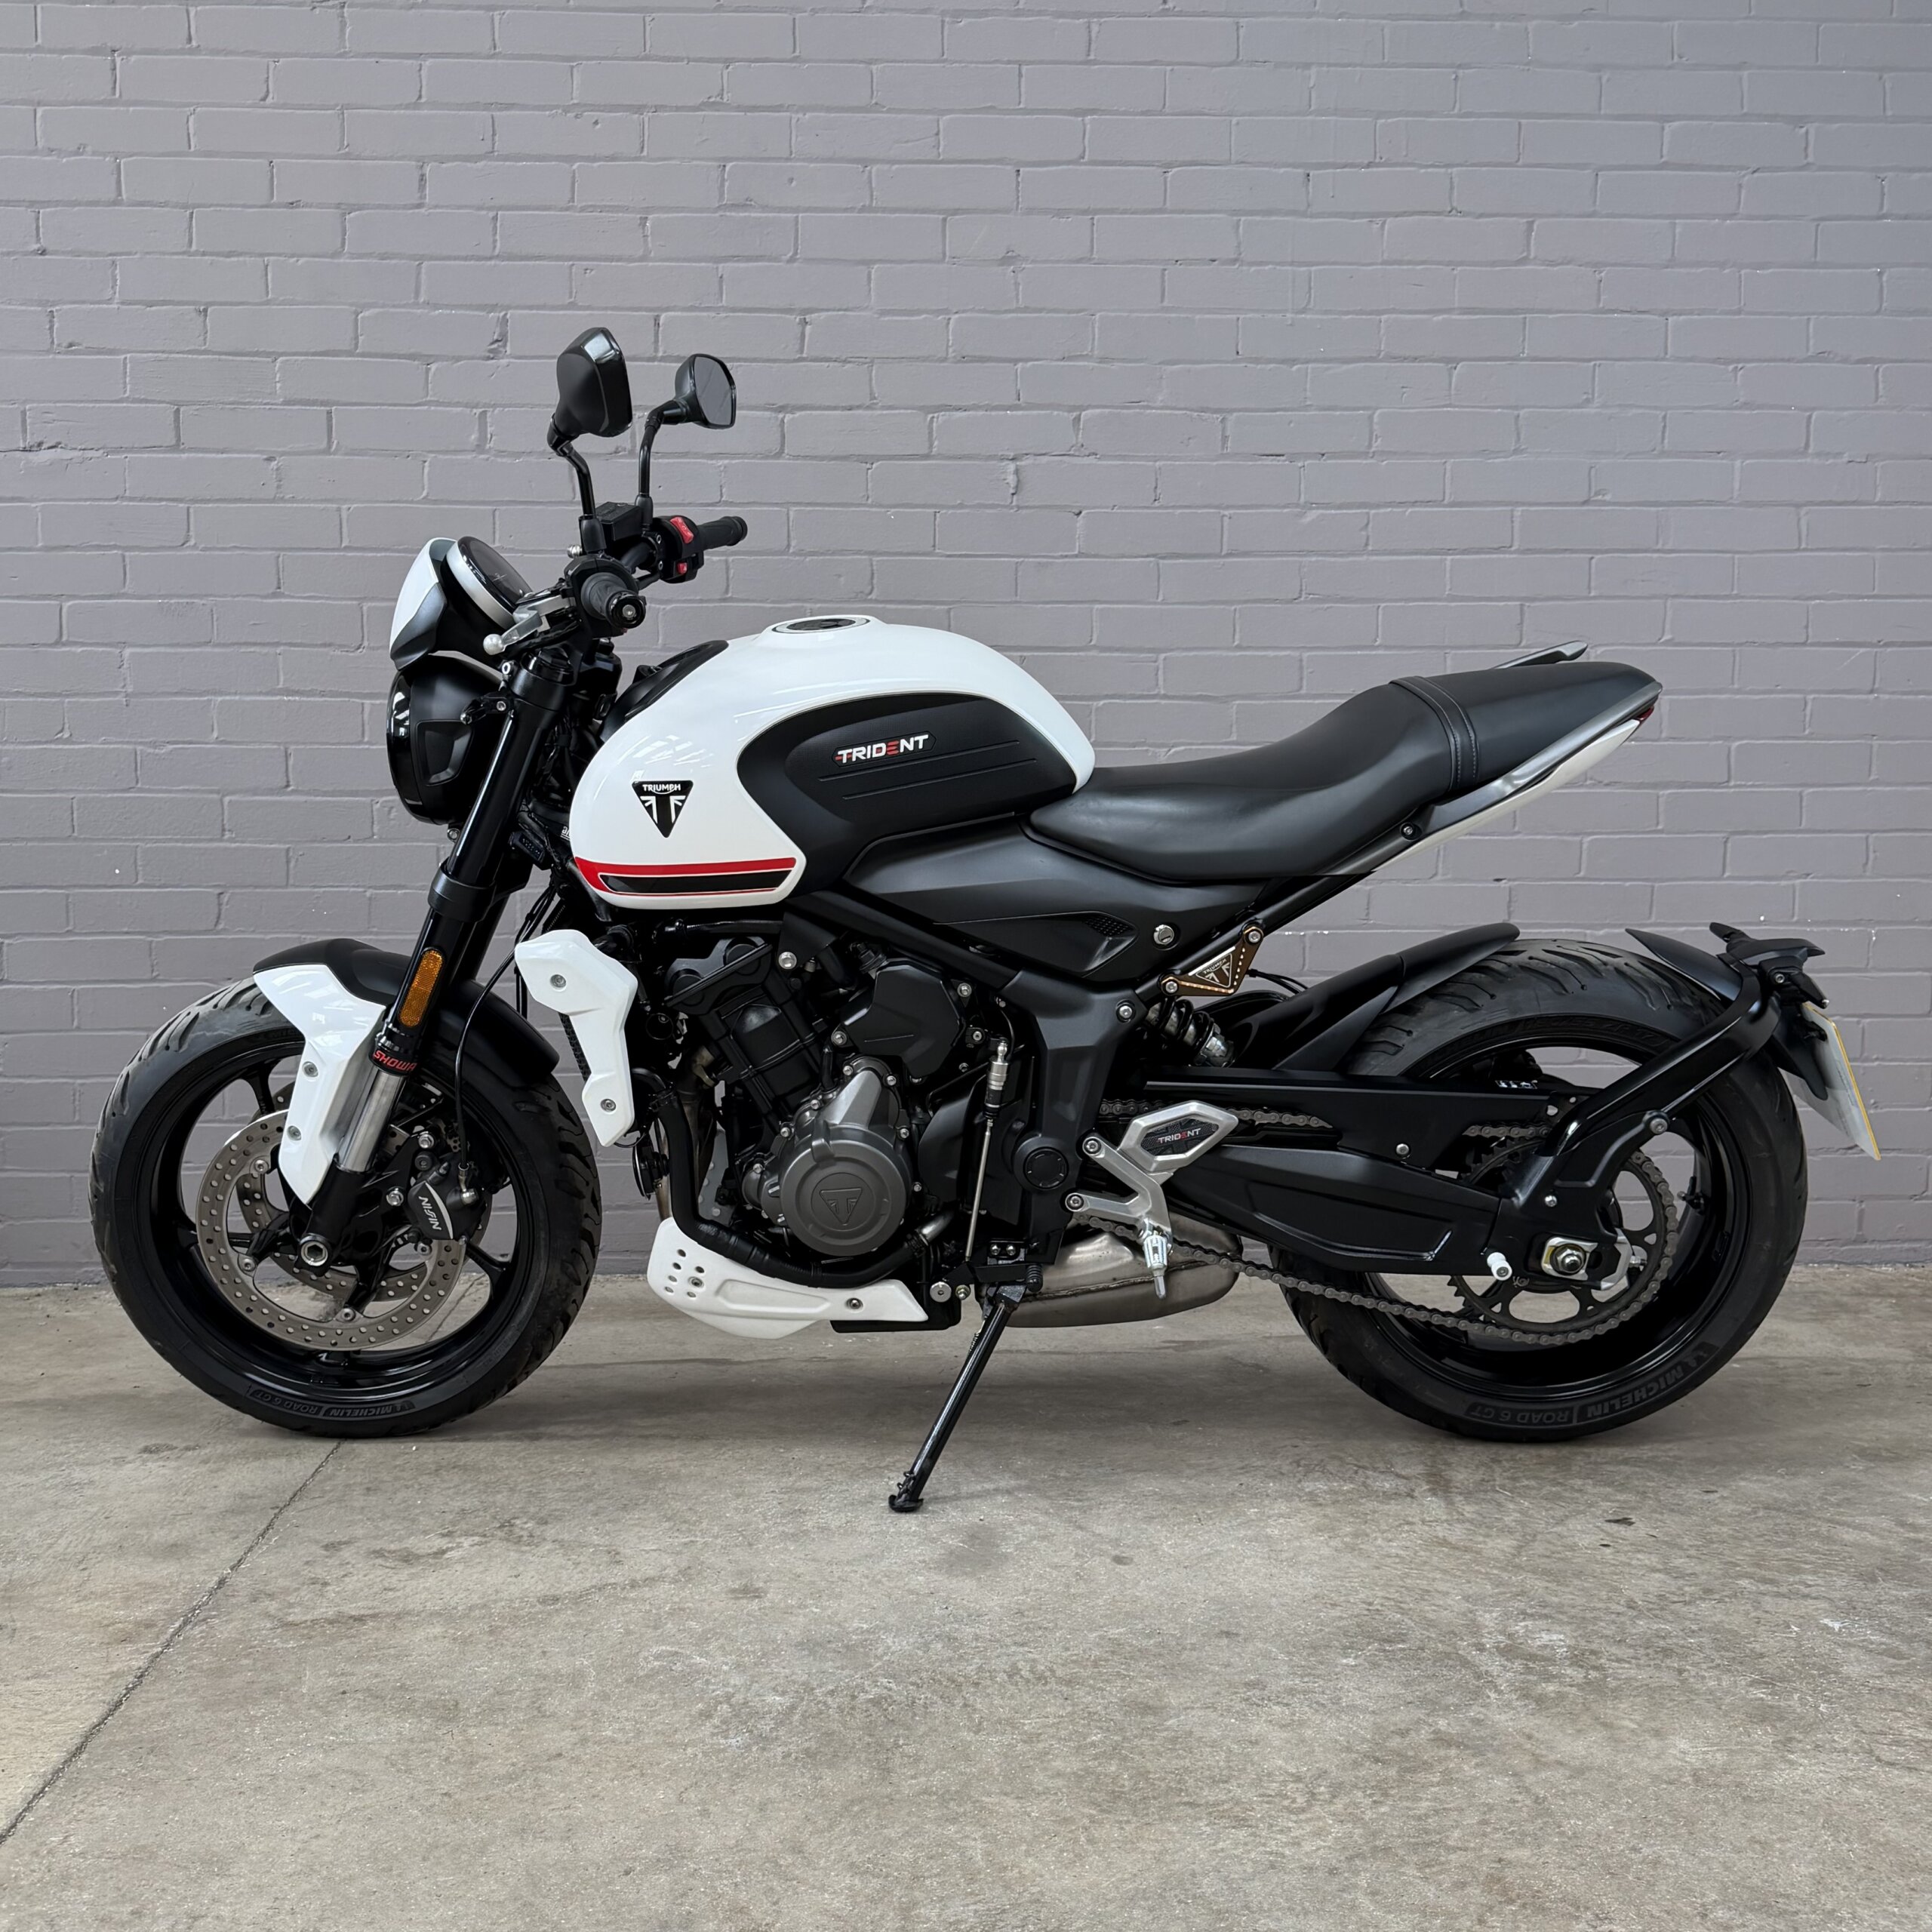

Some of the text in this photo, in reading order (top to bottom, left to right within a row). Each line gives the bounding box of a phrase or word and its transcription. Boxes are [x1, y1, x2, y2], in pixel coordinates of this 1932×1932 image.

[835, 734, 929, 763] TRIDENT
[642, 783, 681, 793] TRIUMPH
[1203, 958, 1227, 974] TRIUMPH
[373, 1050, 417, 1071] SHOWA
[1157, 1128, 1201, 1144] TRIDENT
[255, 1391, 272, 1401] GT
[1471, 1364, 1684, 1424] MICHELIN ROAD 6 GT
[283, 1401, 318, 1414] ROAD
[329, 1404, 393, 1417] MICHELIN
